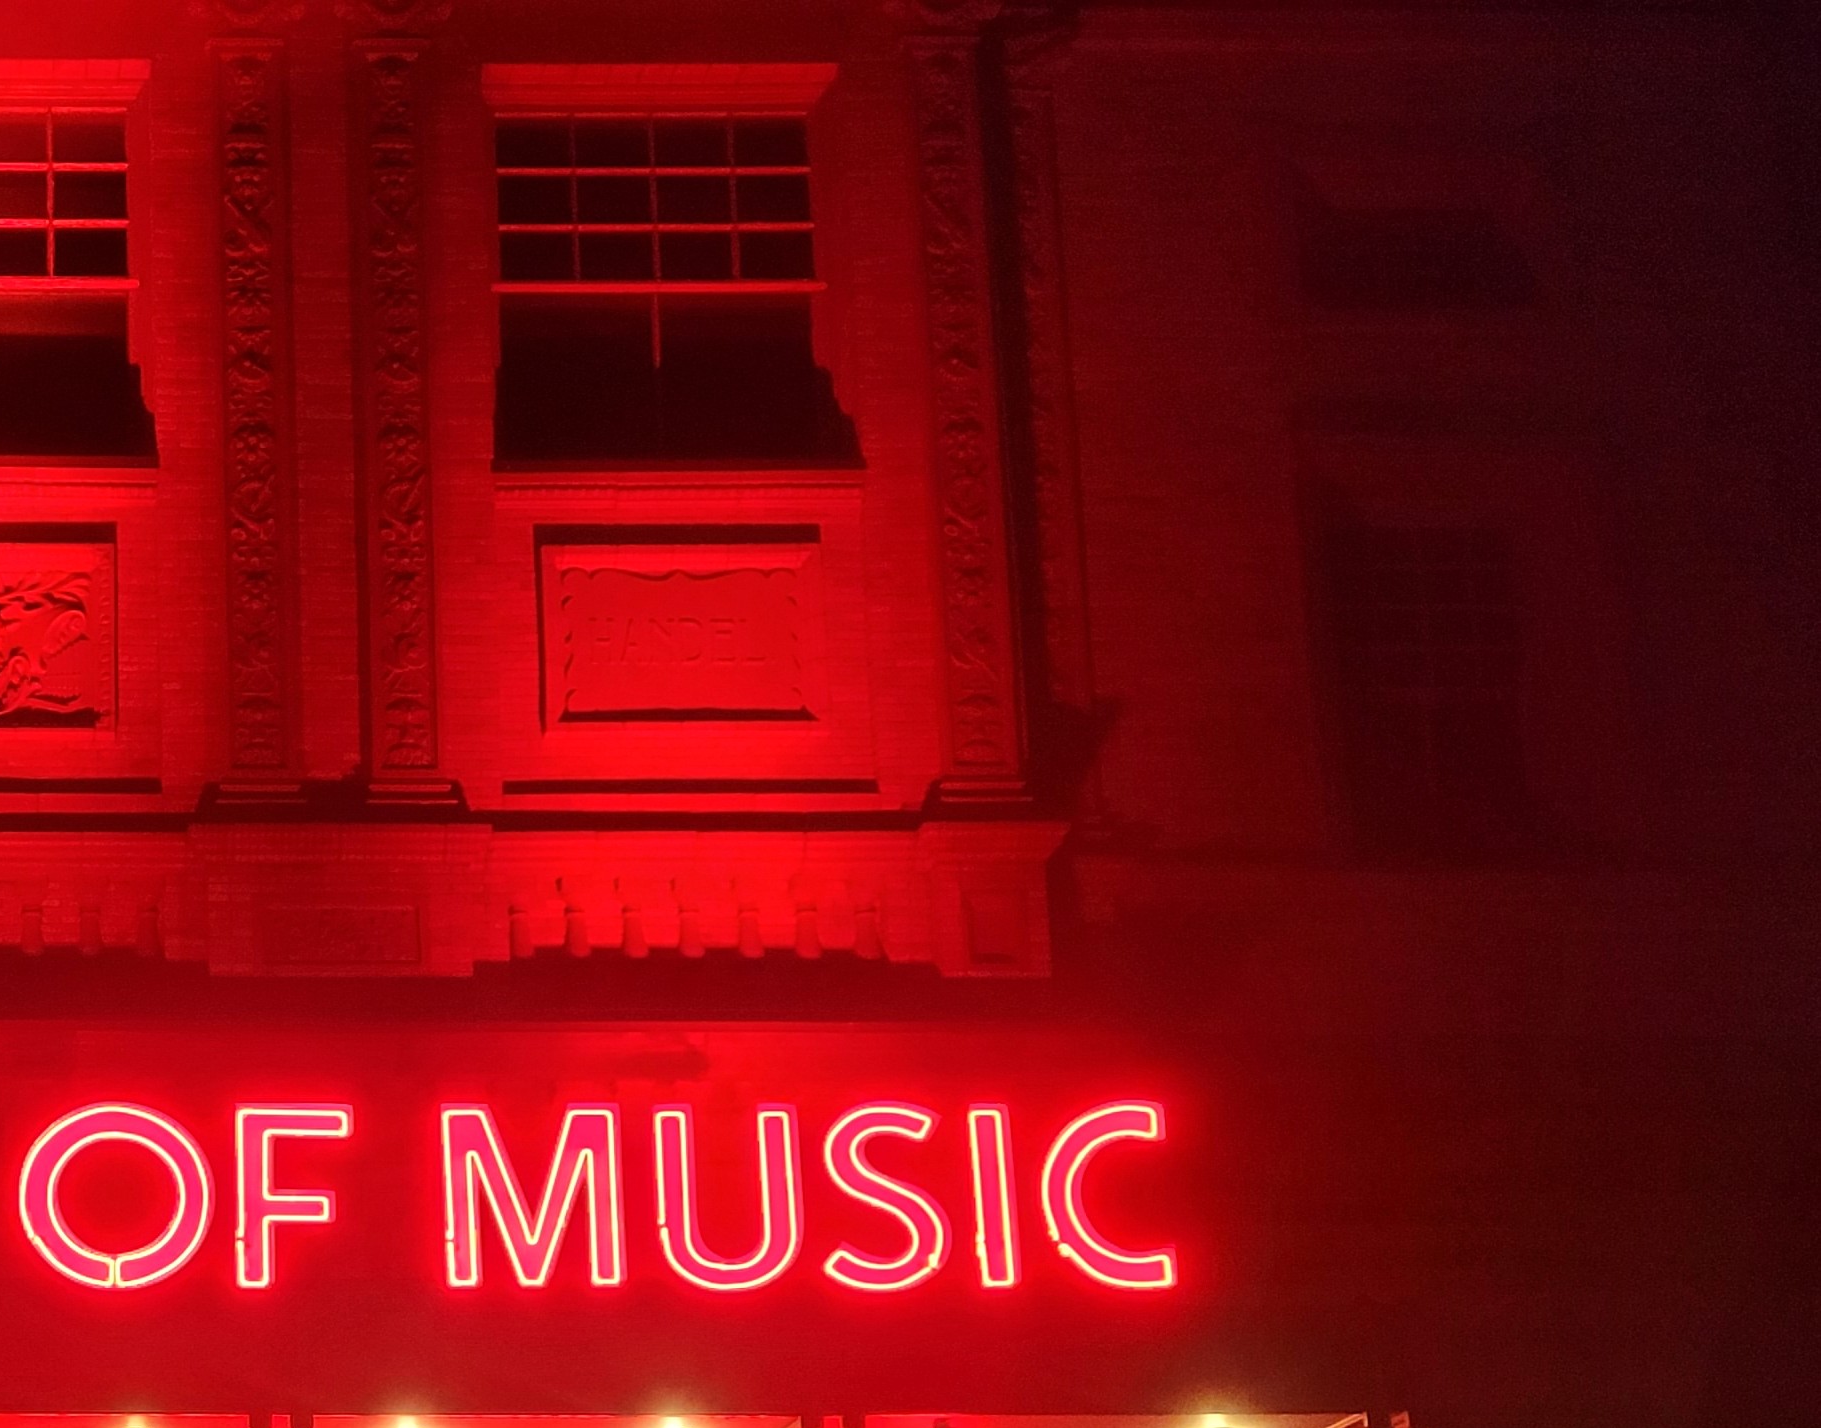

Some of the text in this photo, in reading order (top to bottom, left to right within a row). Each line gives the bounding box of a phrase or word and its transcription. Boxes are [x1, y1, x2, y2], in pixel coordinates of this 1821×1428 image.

[585, 616, 772, 666] HANDEL
[17, 1102, 351, 1290] OF
[439, 1101, 1176, 1291] MUSIC
